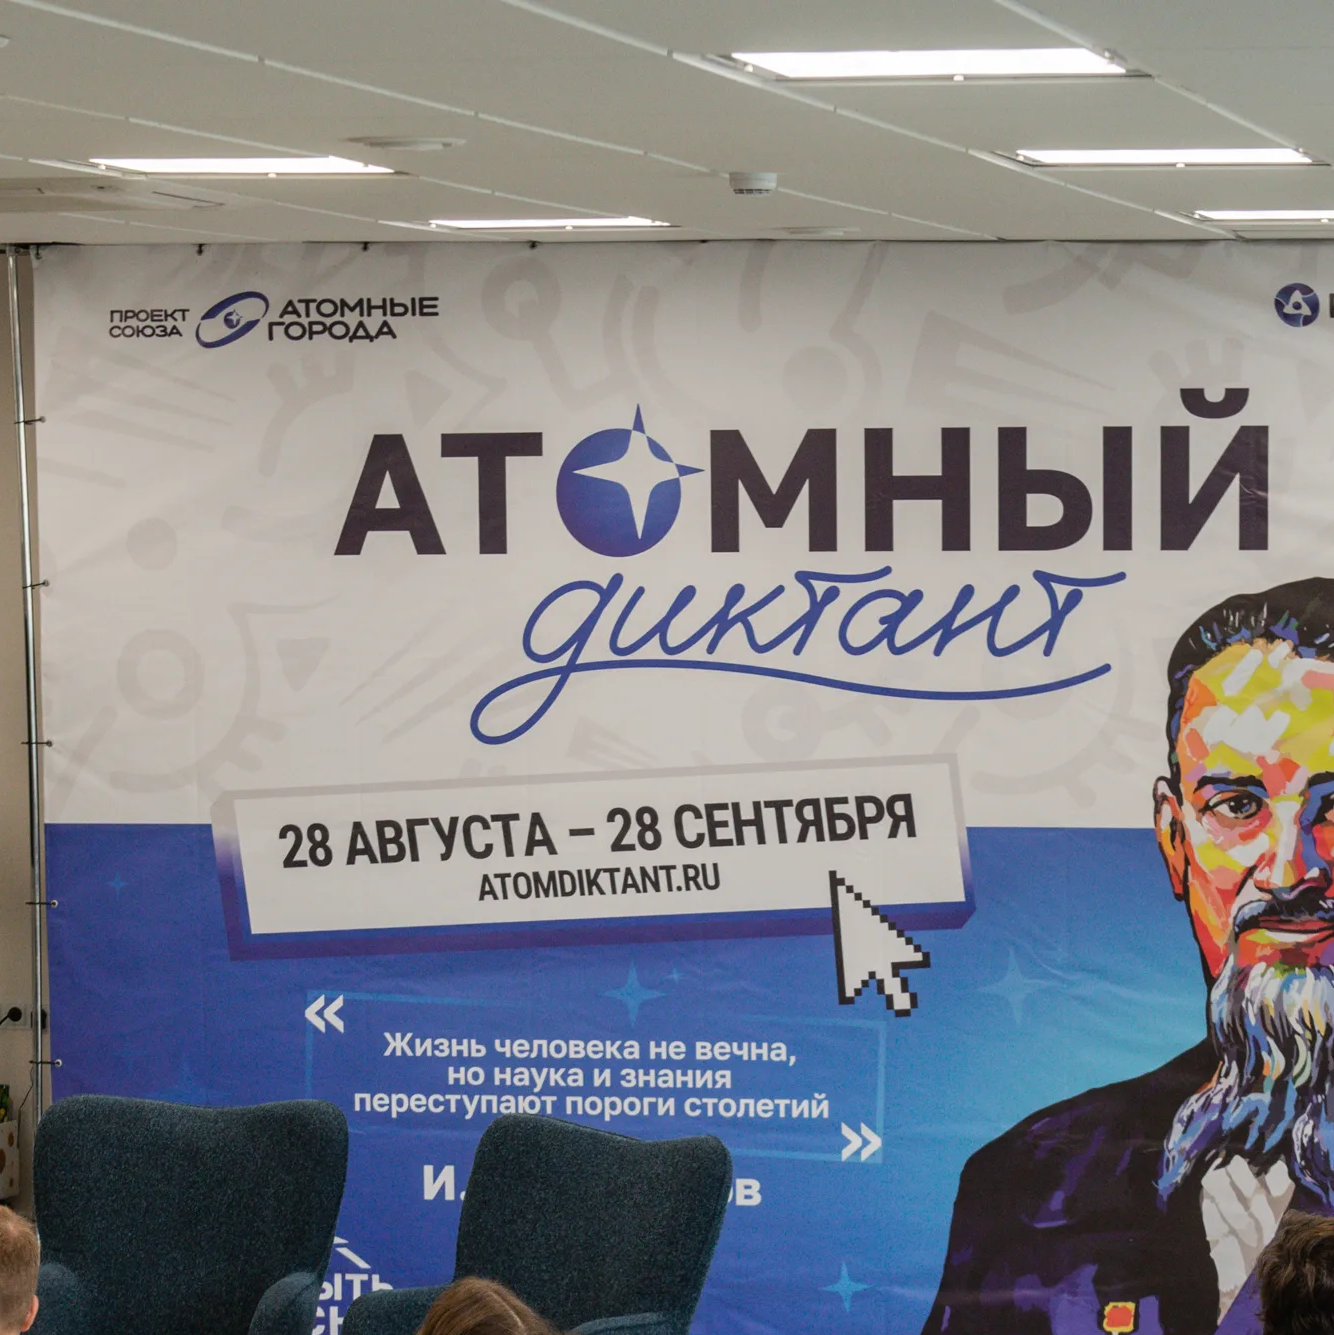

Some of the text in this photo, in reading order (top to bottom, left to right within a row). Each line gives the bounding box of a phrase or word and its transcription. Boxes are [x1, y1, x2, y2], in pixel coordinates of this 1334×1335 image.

[110, 308, 190, 324] ПРОЕКТ
[279, 296, 439, 318] АТОМНЫЕ
[109, 325, 182, 339] СОЮЗА
[268, 319, 397, 343] ГОРОДА
[334, 387, 1268, 556] АТОМНЫЙ
[469, 565, 1126, 745] диктант
[278, 823, 333, 869] 28
[345, 811, 558, 866] АВГУСТА
[609, 807, 662, 852] 28
[674, 792, 917, 849] СЕНТЯБРЯ
[478, 862, 721, 901] ATOMDIKTANT.RU
[383, 1031, 797, 1067] Жизнь человека не вечна,
[447, 1063, 732, 1093] но наука и знания
[353, 1091, 829, 1122] переступают пороги столетий
